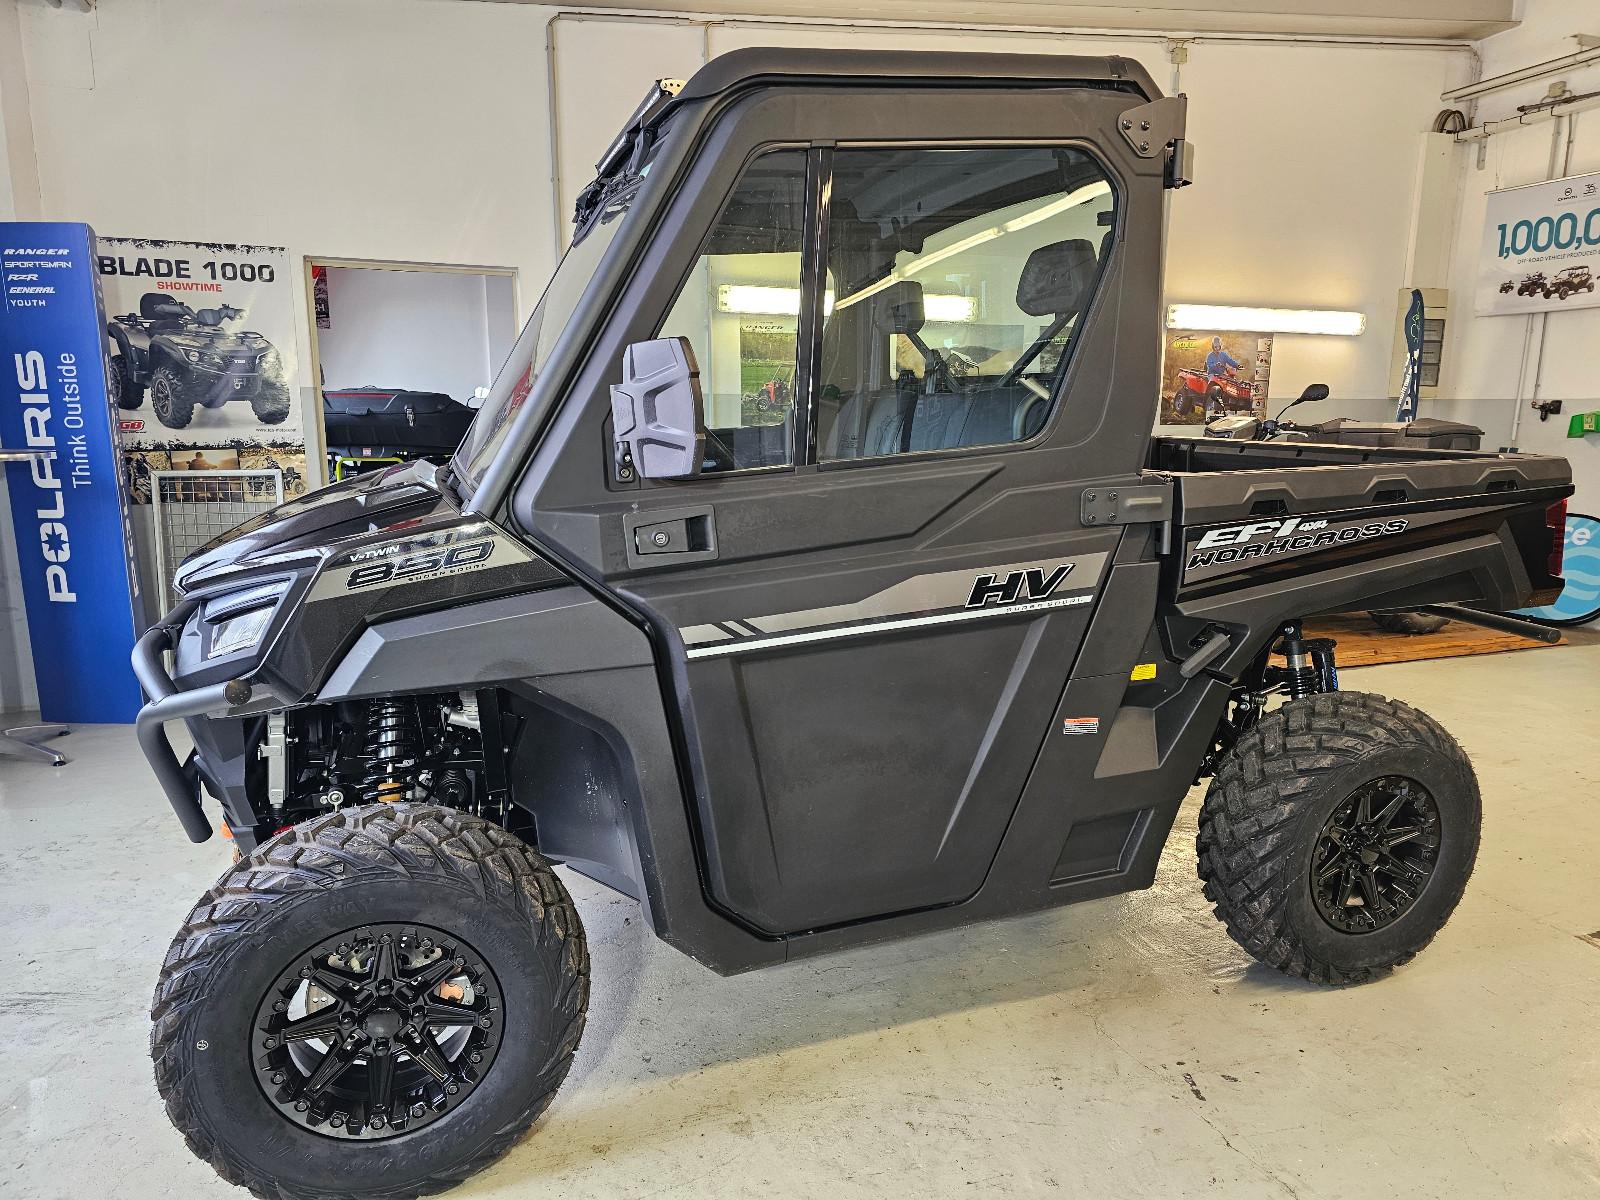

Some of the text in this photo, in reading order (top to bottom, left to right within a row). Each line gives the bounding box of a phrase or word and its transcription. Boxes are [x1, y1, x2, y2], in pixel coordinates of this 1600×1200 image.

[8, 273, 39, 281] RZR
[98, 255, 275, 283] BLADE 1000
[9, 286, 56, 294] GENERAL
[157, 281, 223, 292] SHOWTIME
[10, 299, 46, 307] YOUTH
[57, 353, 92, 489] Think Outside
[14, 350, 77, 603] POLARIS
[1195, 517, 1302, 550] EFI
[346, 540, 494, 589] 850
[349, 545, 400, 562] V-TWIN
[964, 563, 1075, 608] HV
